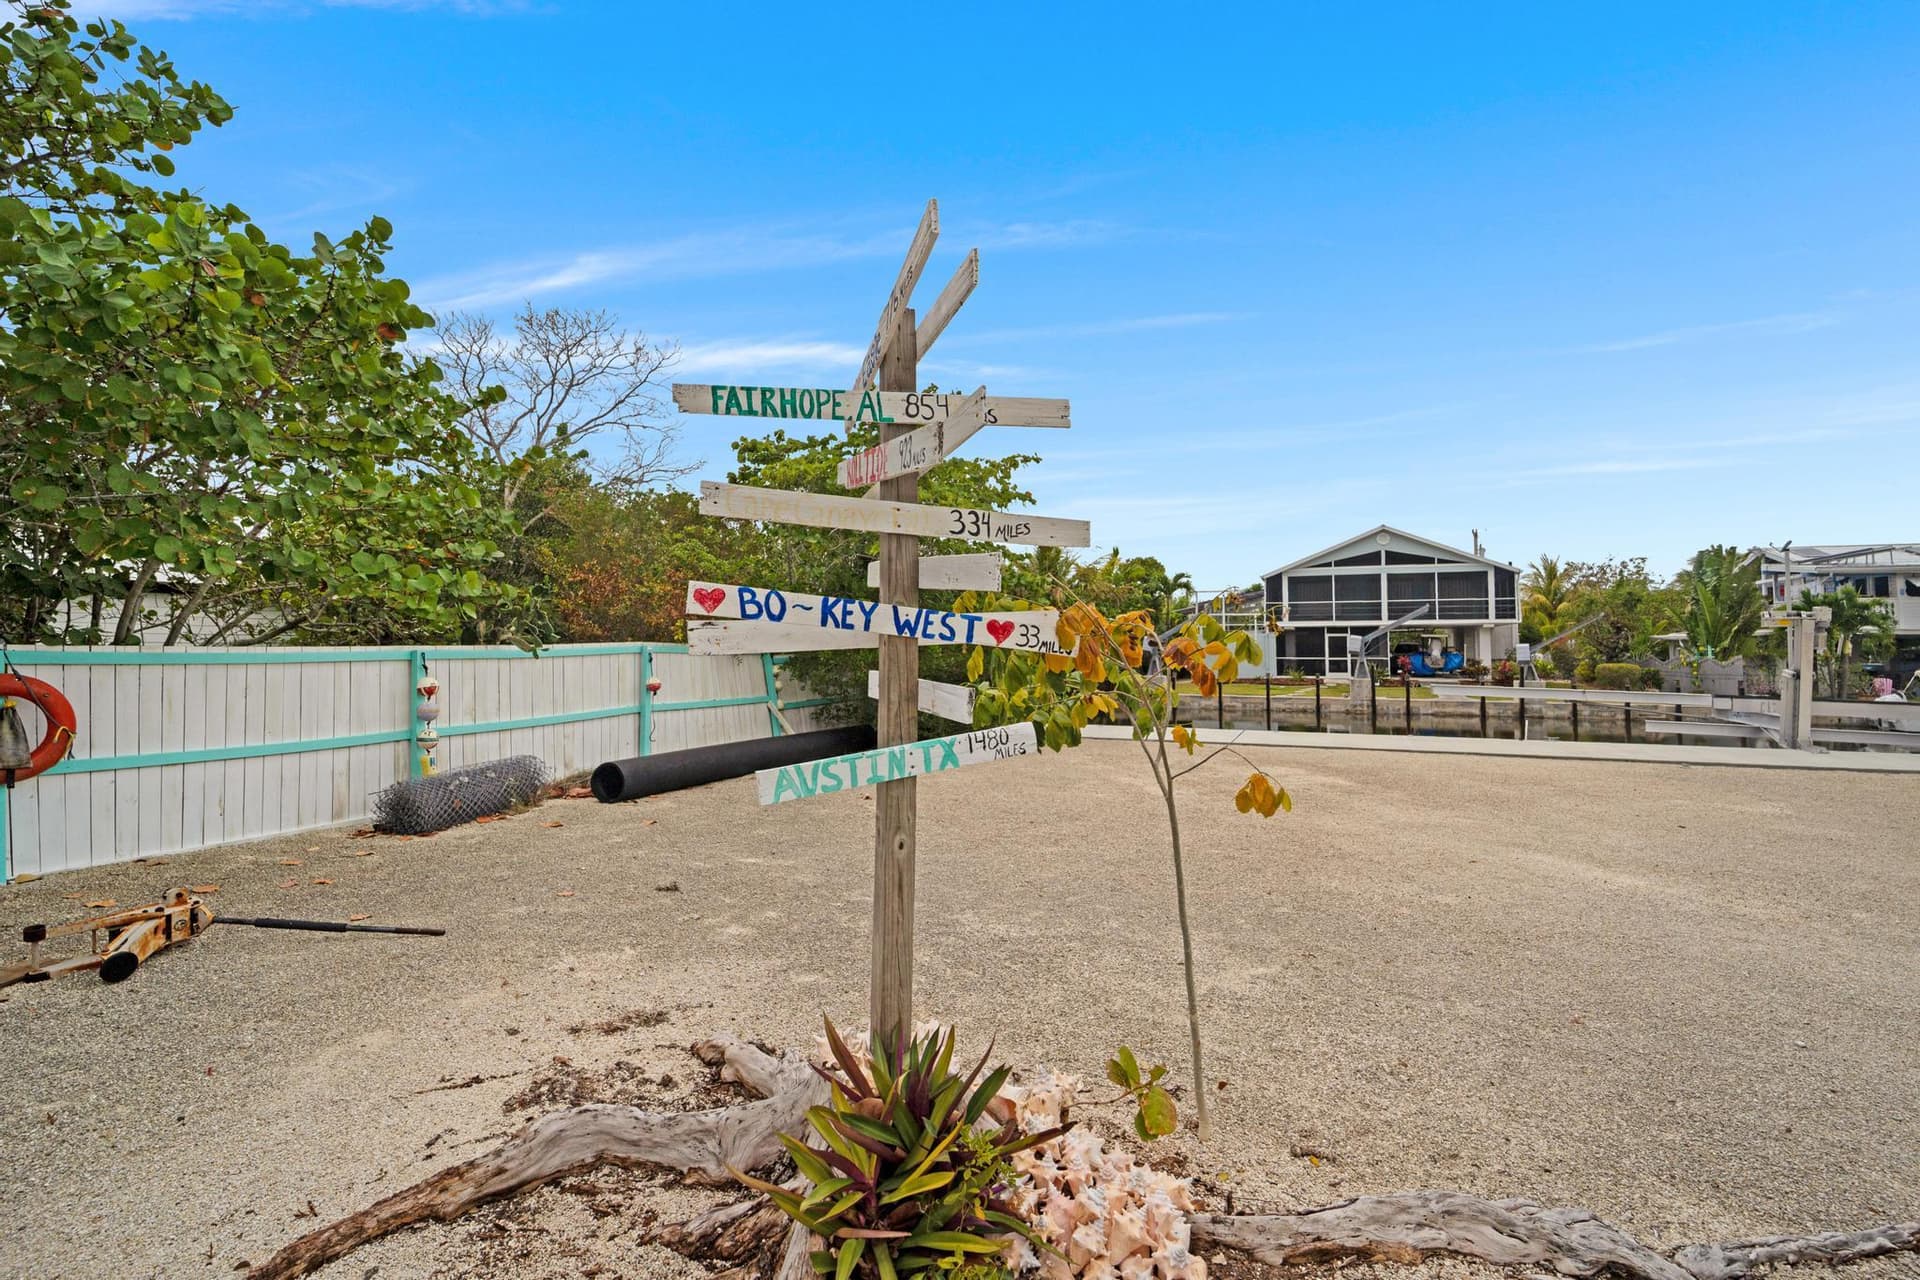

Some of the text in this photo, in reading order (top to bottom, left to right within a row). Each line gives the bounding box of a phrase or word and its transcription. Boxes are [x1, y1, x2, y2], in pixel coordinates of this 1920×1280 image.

[856, 390, 894, 423] AL
[905, 393, 949, 421] 854
[949, 509, 1031, 542] 334 MILES
[820, 595, 879, 632] KEY
[892, 605, 983, 644] WEST
[1015, 624, 1041, 648] 33
[912, 736, 960, 774] TX
[967, 728, 1009, 754] 1480
[994, 742, 1026, 760] MILES
